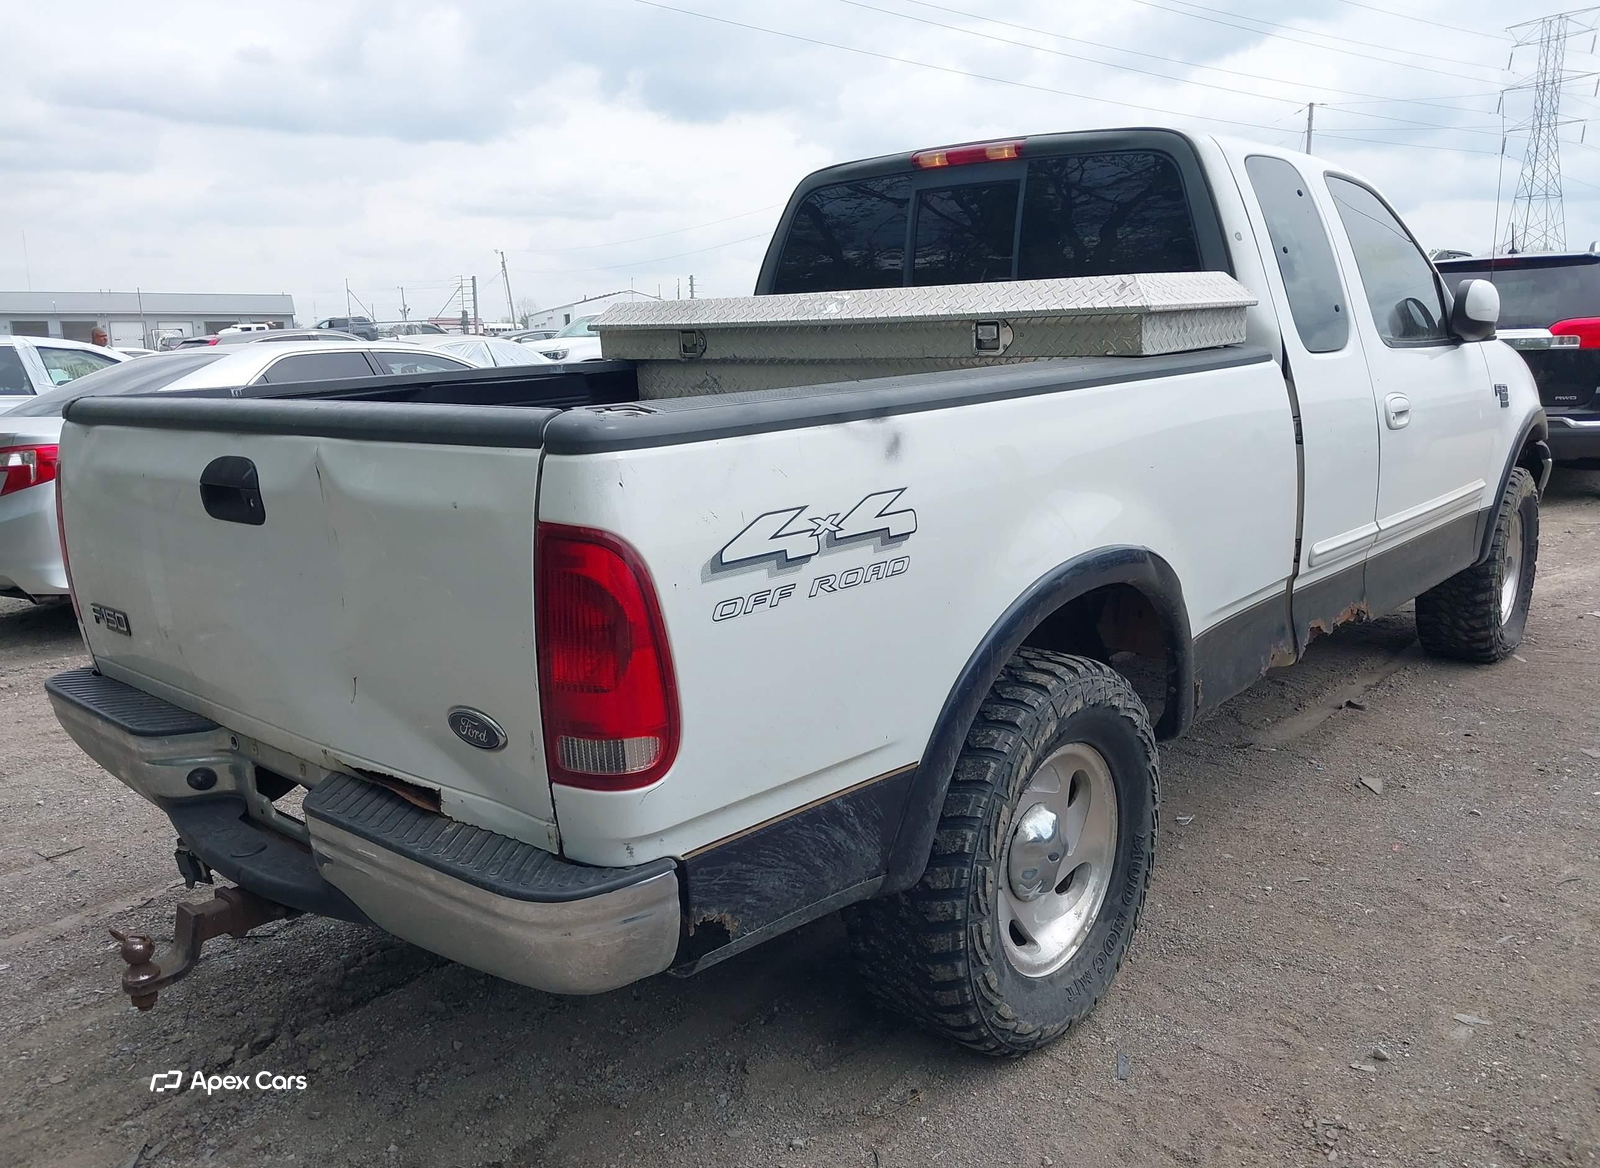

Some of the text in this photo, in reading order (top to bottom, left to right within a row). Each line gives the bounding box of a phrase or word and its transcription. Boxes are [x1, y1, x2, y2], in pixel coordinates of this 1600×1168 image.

[712, 487, 918, 568] 4x4
[712, 555, 911, 622] OFF ROAD
[459, 717, 488, 742] Ford
[1122, 833, 1147, 906] MUD
